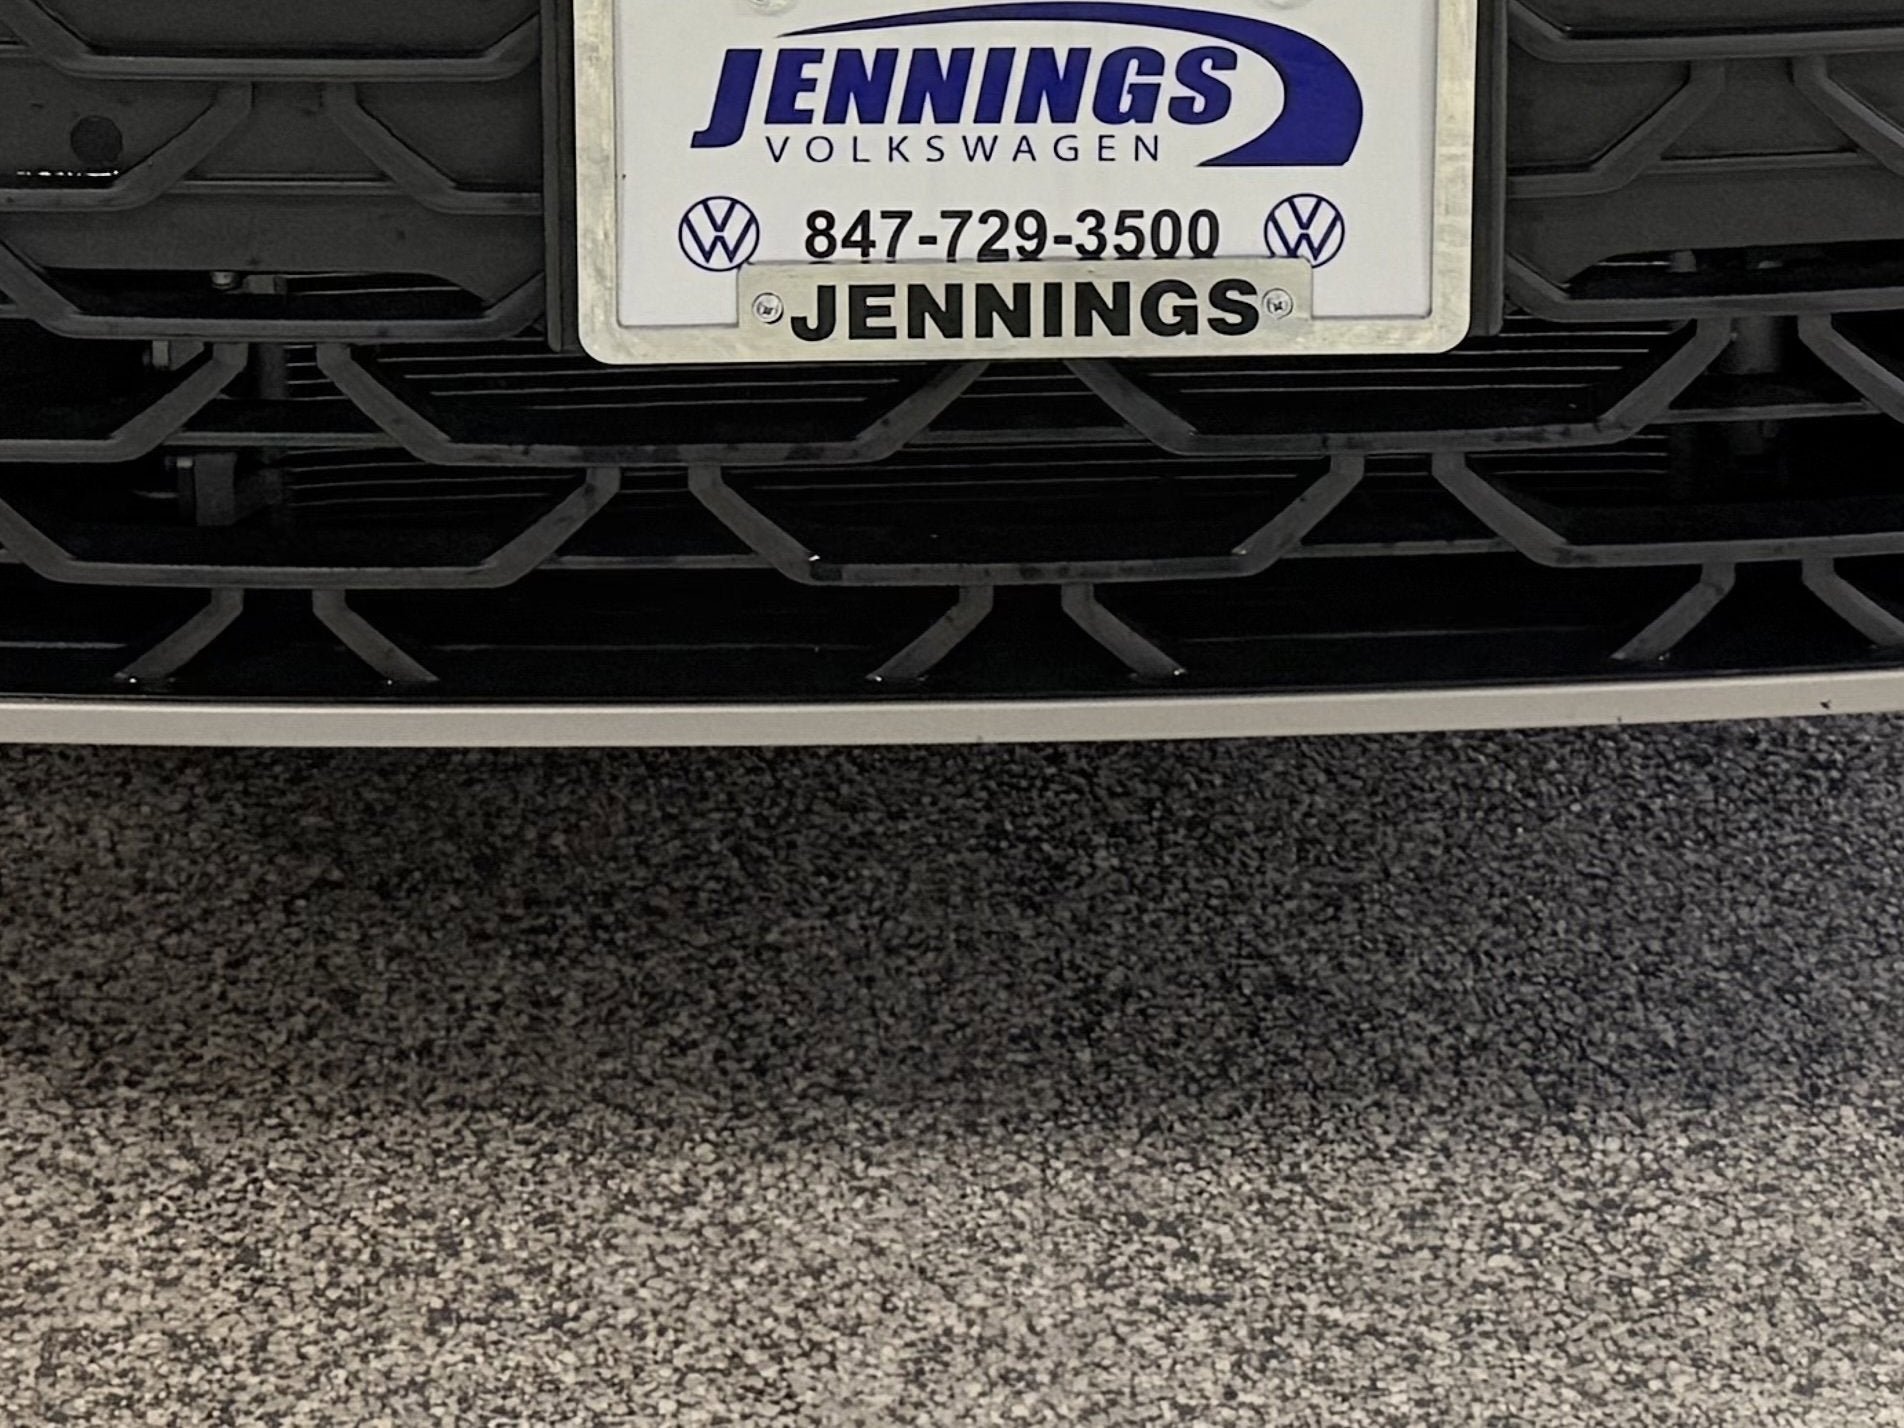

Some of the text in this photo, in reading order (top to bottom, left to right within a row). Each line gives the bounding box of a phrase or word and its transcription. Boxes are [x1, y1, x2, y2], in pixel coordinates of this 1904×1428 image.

[689, 44, 1239, 150] JENNINGS
[763, 132, 1161, 165] VOLKSWAGEN
[803, 207, 1221, 263] 847-729-3500
[789, 277, 1261, 343] JENNINGS
